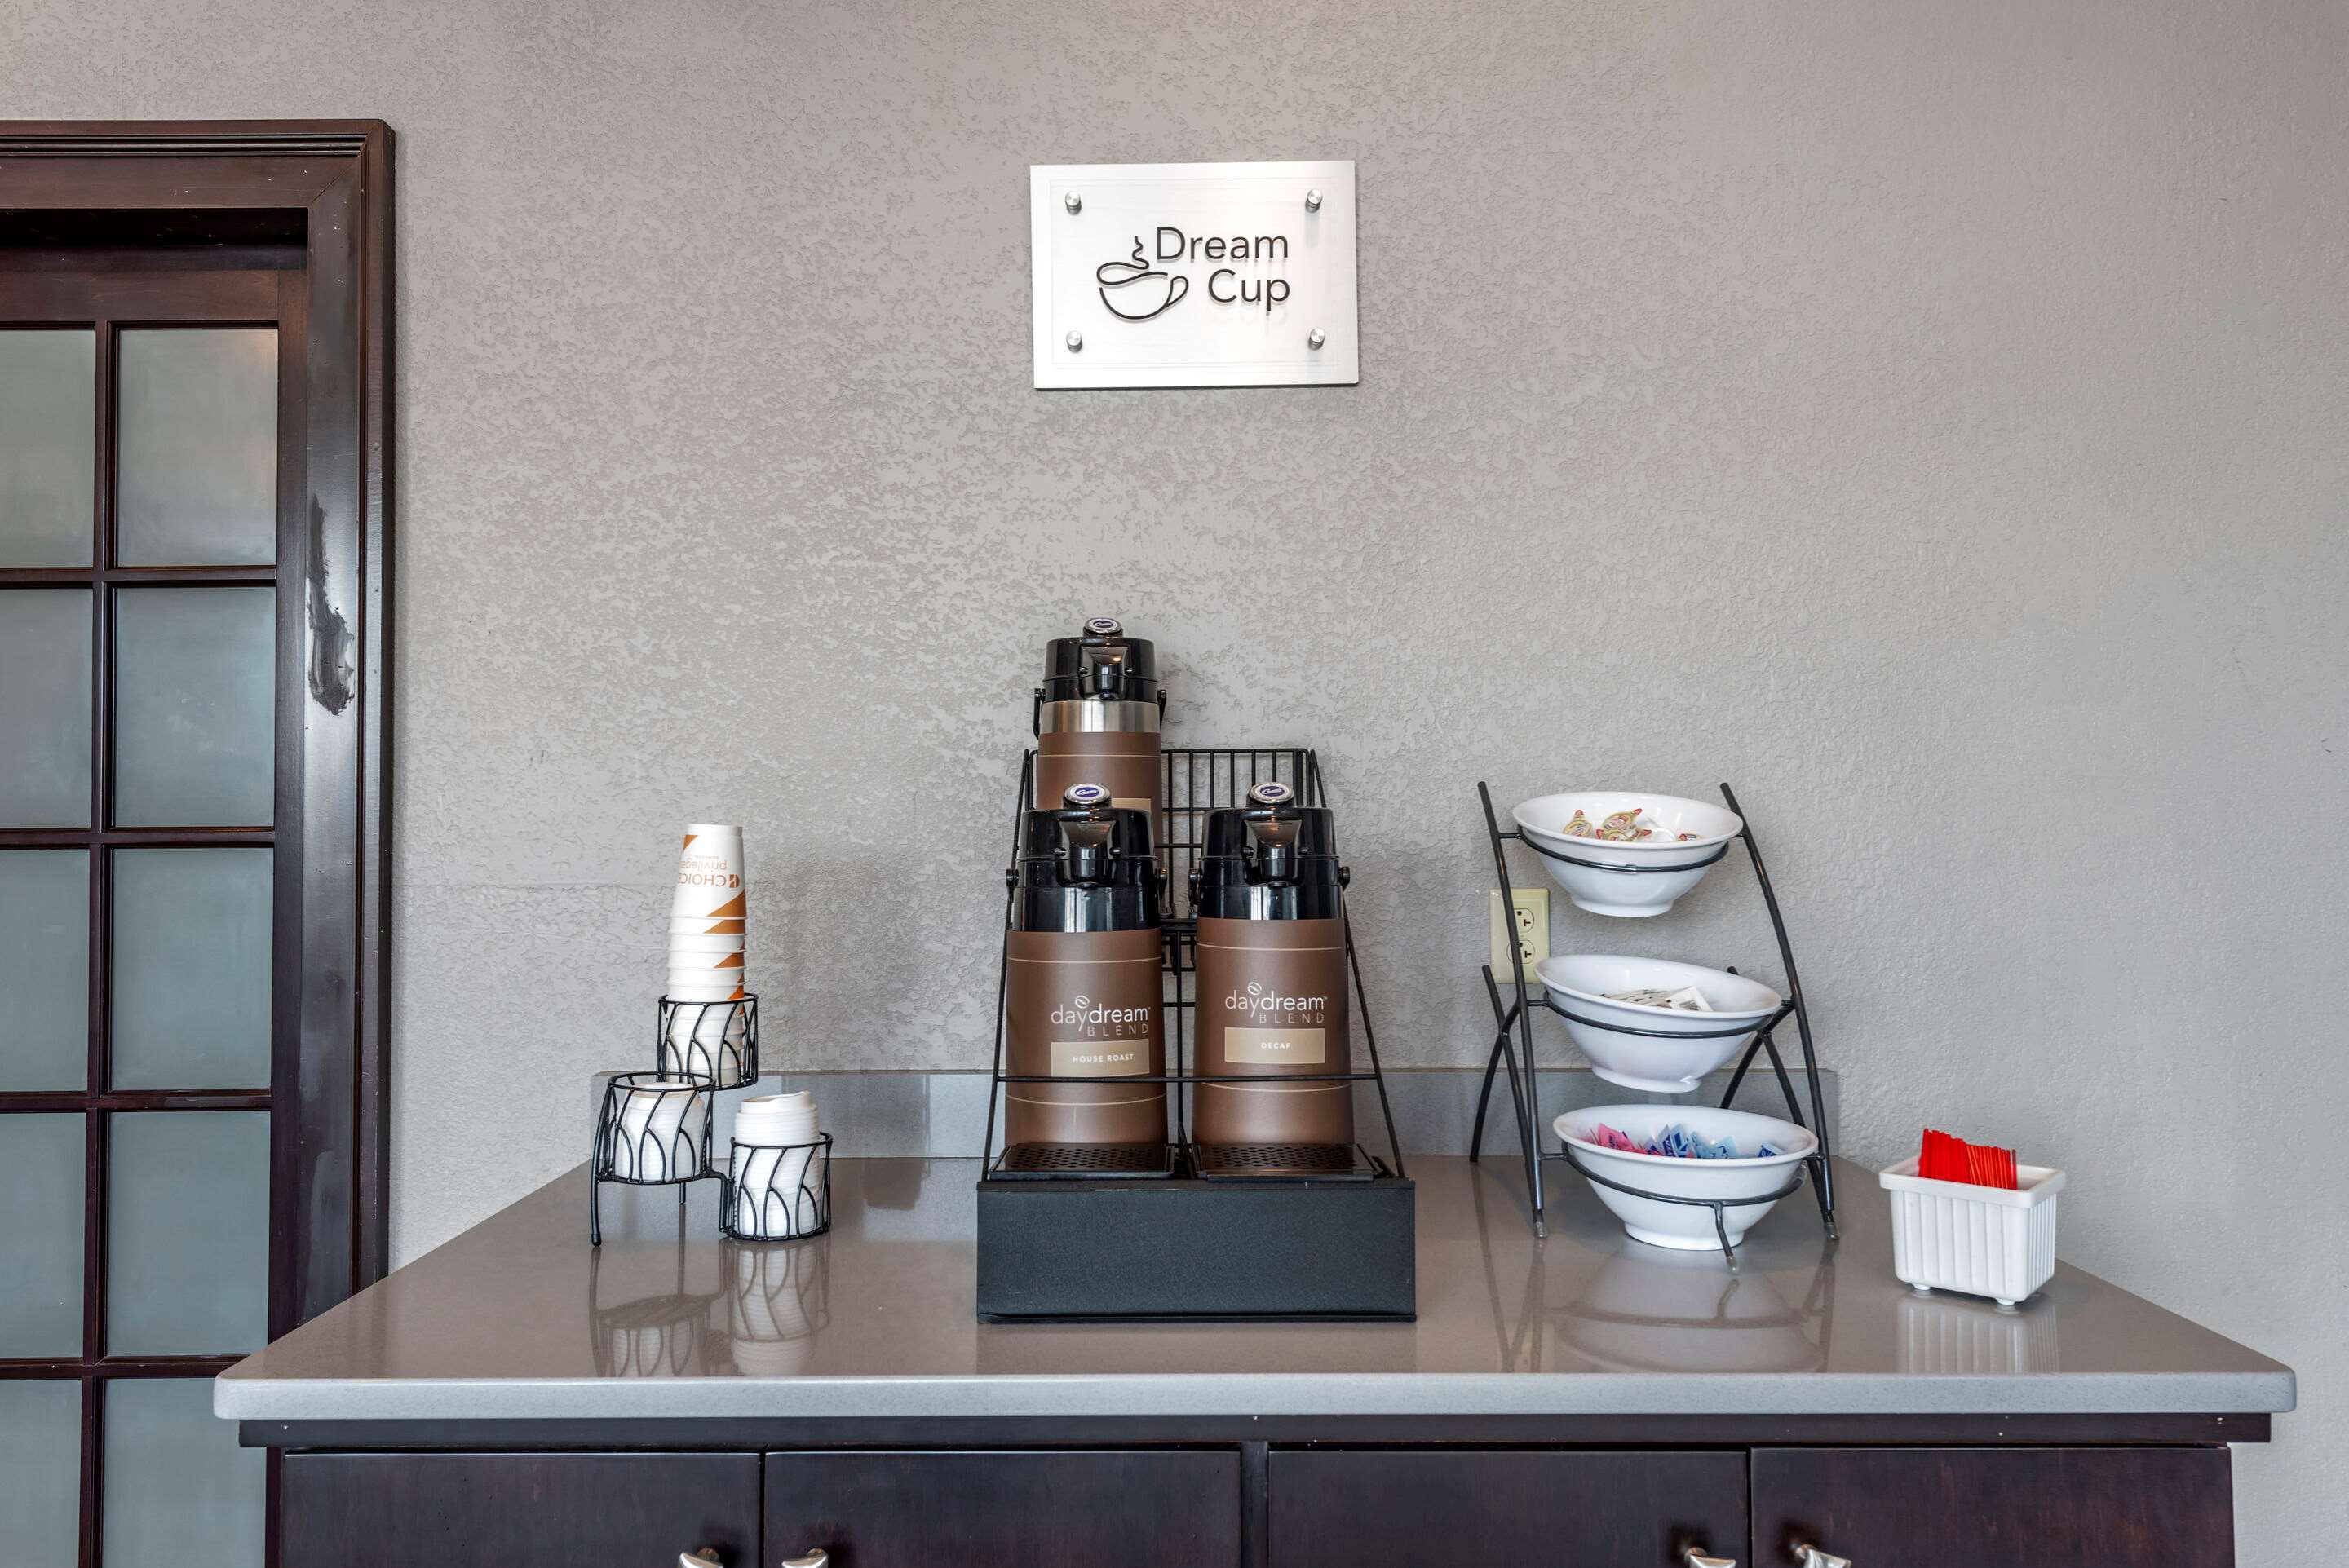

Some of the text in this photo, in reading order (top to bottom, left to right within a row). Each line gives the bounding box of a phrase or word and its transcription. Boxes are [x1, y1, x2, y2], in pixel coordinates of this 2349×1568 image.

[1157, 227, 1289, 261] Dream
[1208, 268, 1290, 312] Cup
[1051, 1003, 1148, 1031] daydream
[1225, 989, 1325, 1018] daydream
[1087, 1023, 1148, 1036] BLEND
[1259, 1013, 1325, 1024] BLEND
[1073, 1053, 1135, 1063] HOUSE ROAST
